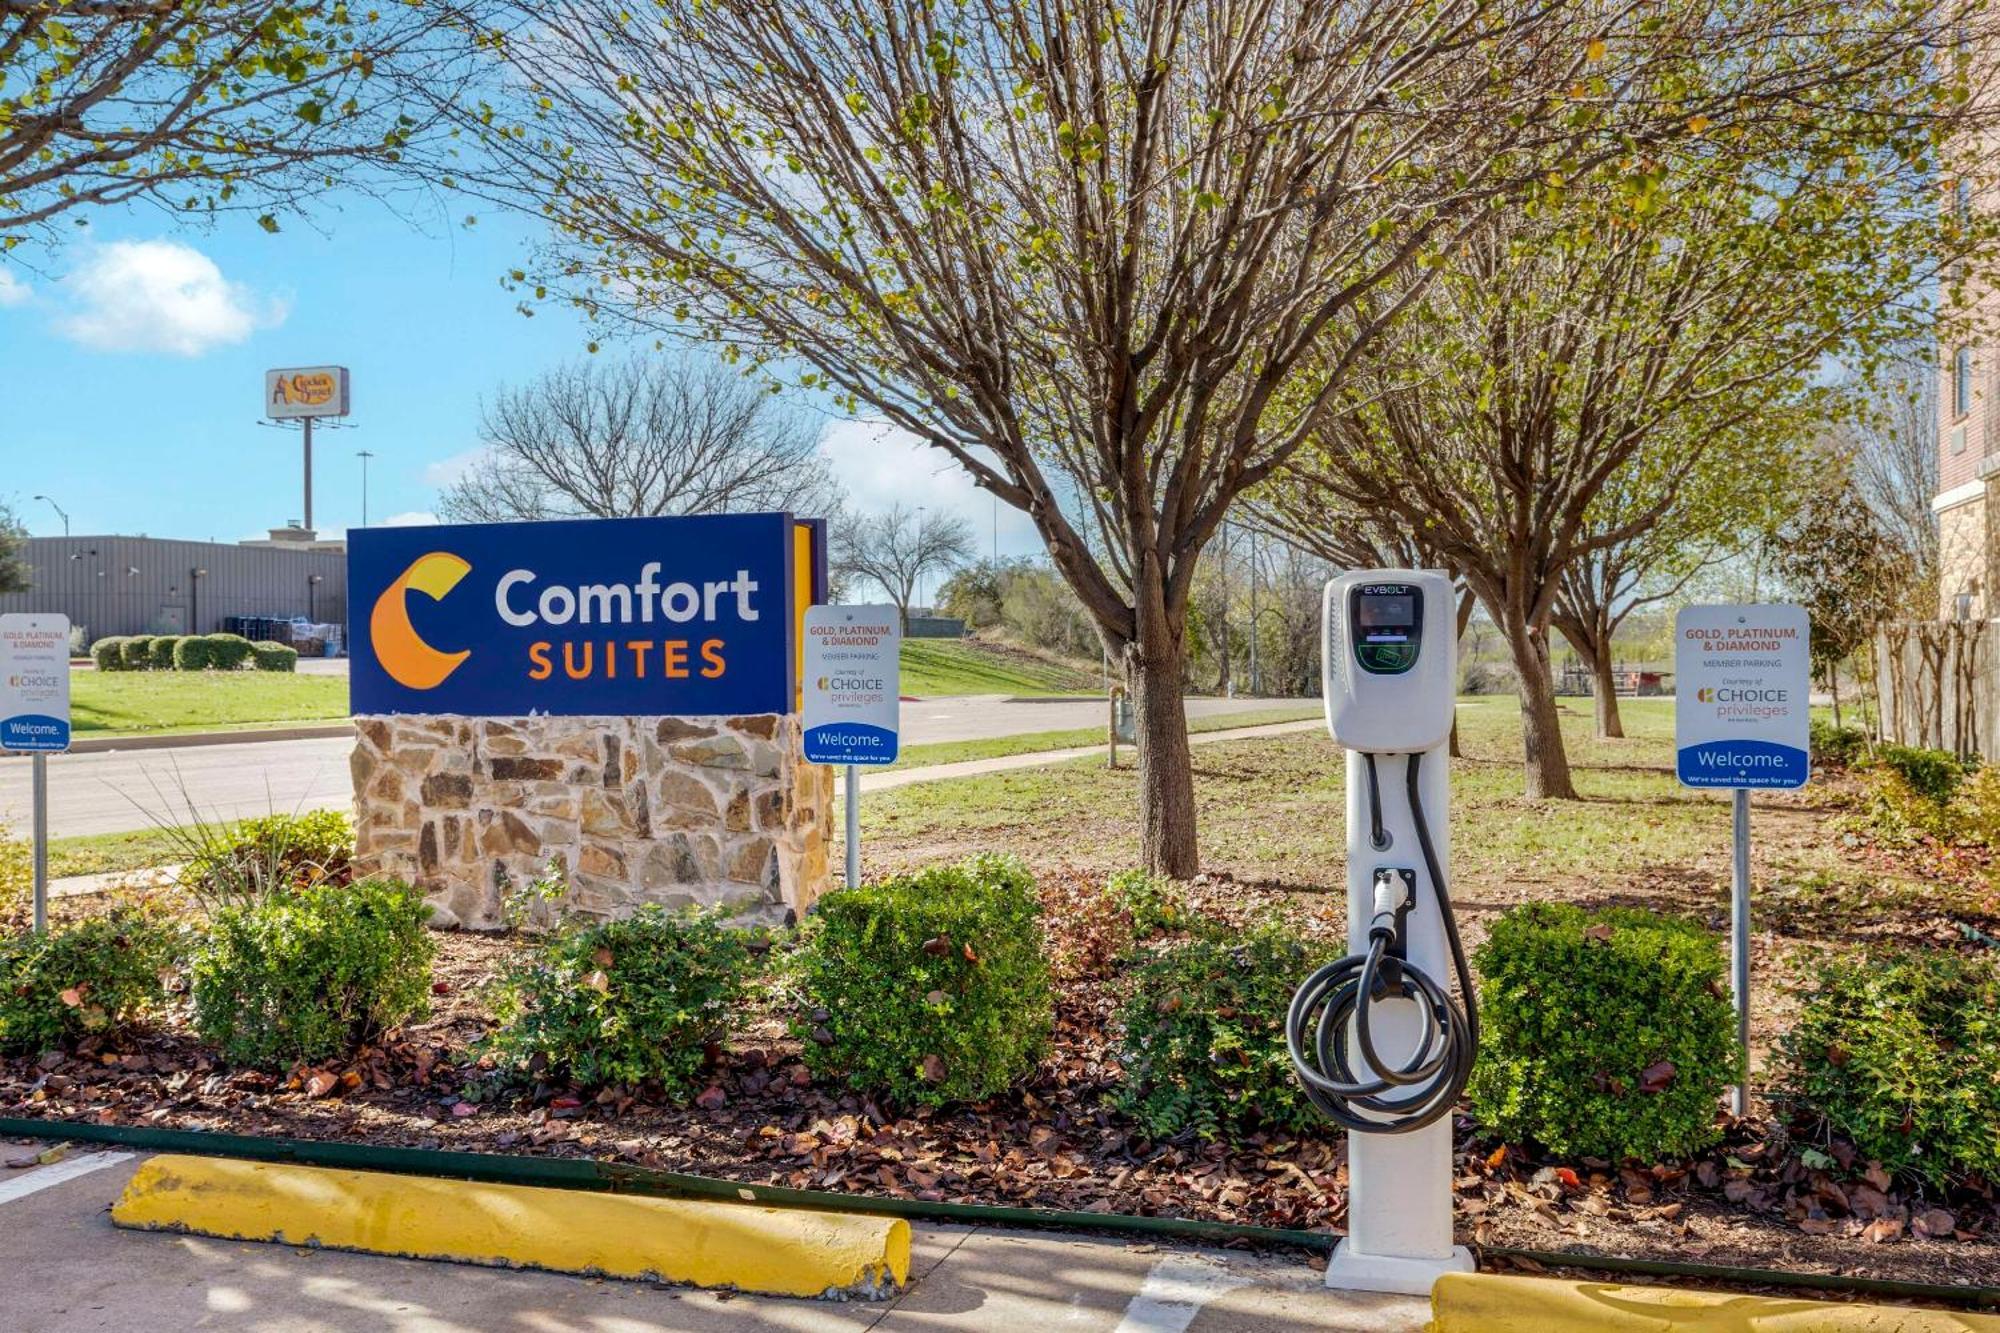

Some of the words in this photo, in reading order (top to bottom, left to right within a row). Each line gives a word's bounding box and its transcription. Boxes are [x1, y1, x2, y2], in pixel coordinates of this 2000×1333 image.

[495, 562, 759, 627] Comfort
[1364, 586, 1408, 594] EVBOLT
[810, 626, 837, 636] GOLD,
[839, 625, 892, 636] PLATINUM,
[1686, 629, 1725, 640] GOLD,
[1728, 628, 1799, 640] PLATINUM,
[822, 637, 829, 646] &
[831, 636, 879, 646] DIAMOND
[1704, 641, 1712, 651] &
[1716, 640, 1781, 651] DIAMOND
[528, 639, 726, 680] SUITES
[1703, 659, 1741, 667] MEMBER
[1743, 659, 1782, 667] PARKING
[21, 676, 60, 687] CHOICE
[831, 678, 884, 690] CHOICE
[831, 691, 884, 705] privileges
[1717, 688, 1788, 702] CHOICE
[1717, 703, 1789, 719] privileges
[10, 722, 60, 735] Welcome.
[817, 732, 884, 747] Welcome.
[1698, 751, 1789, 768] Welcome.
[1748, 777, 1769, 785] space
[1770, 776, 1781, 784] for
